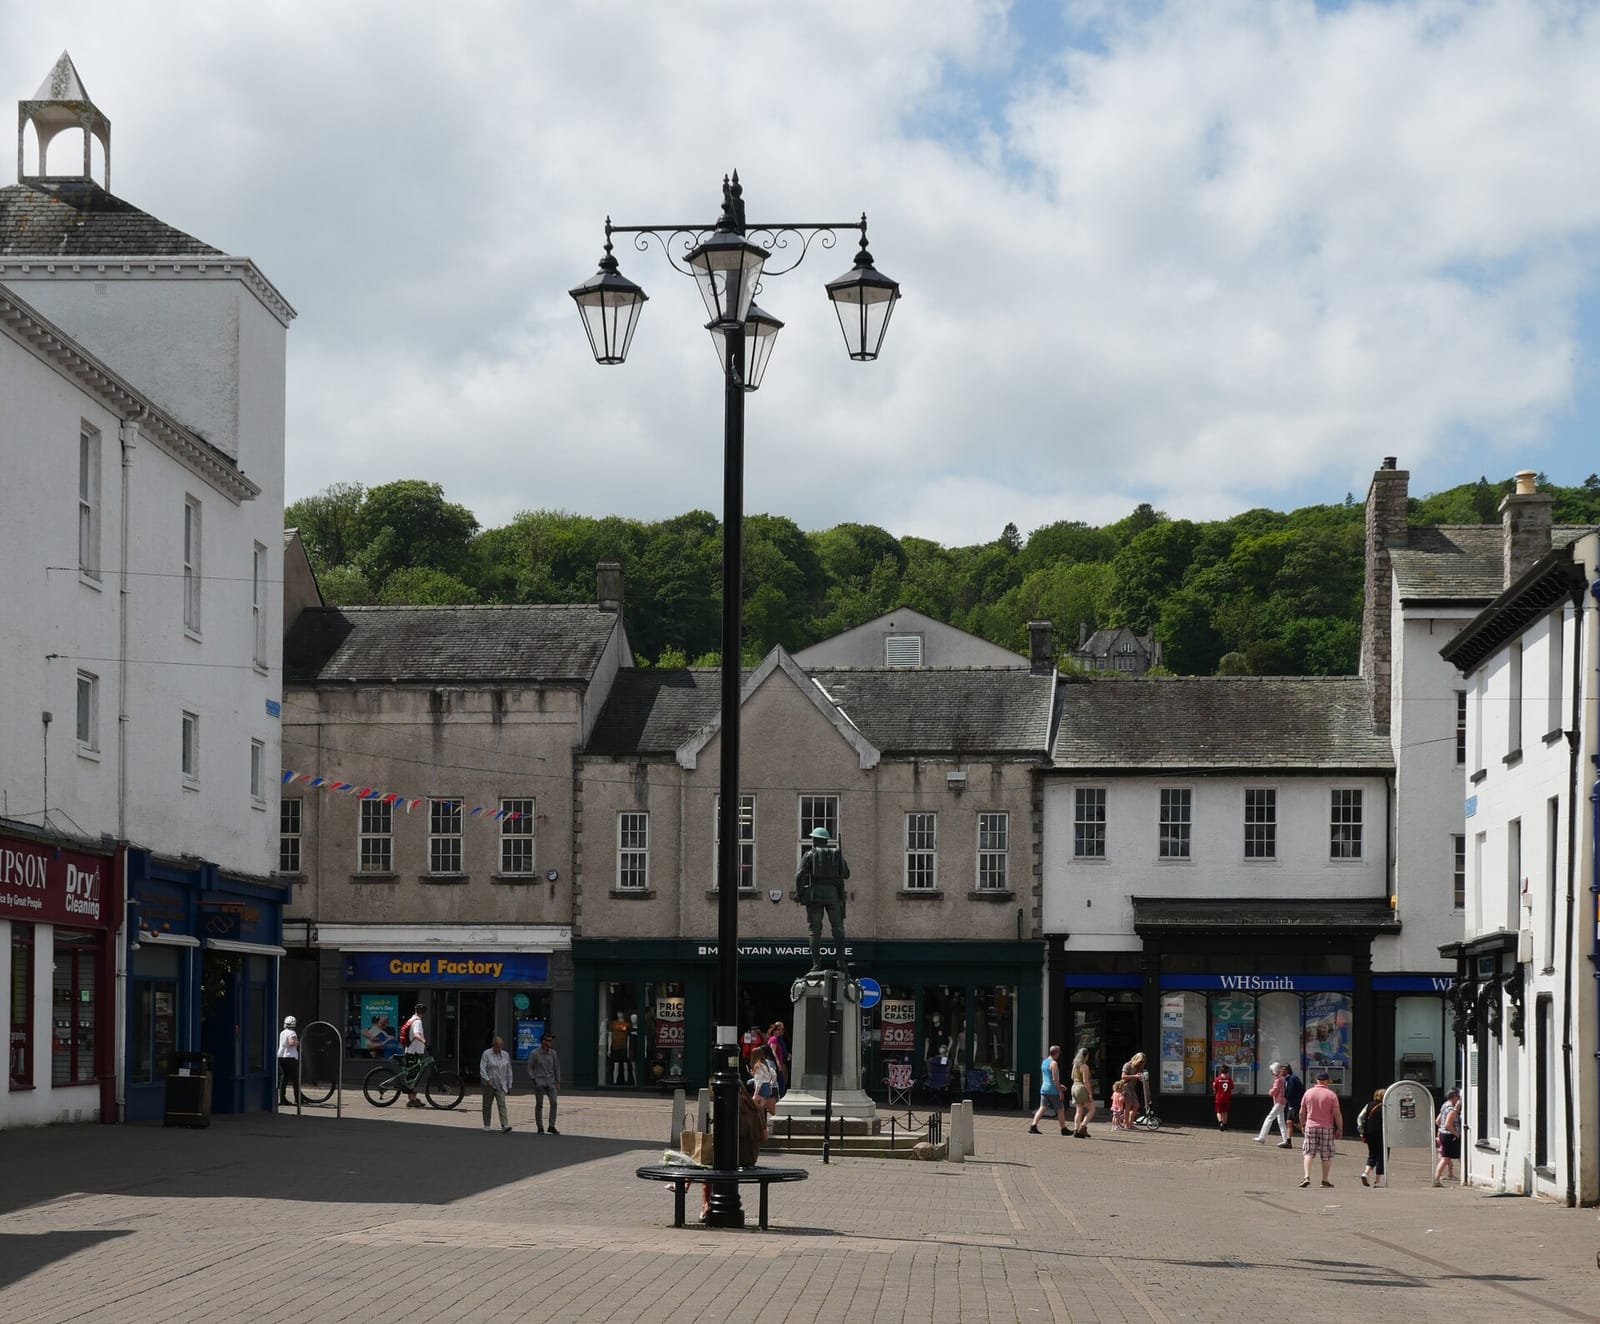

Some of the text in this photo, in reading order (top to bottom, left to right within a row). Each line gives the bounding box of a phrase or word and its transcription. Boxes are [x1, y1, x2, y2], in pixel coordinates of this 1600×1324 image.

[65, 863, 94, 899] Dry
[6, 893, 13, 907] By
[13, 894, 27, 907] Great
[26, 896, 43, 911] People
[65, 893, 101, 921] Cleaning
[707, 946, 854, 956] MNTAIN WAREOUE
[389, 959, 503, 978] Card Factory
[1219, 975, 1295, 991] WHSmith
[659, 1002, 683, 1011] PRIC
[884, 1004, 914, 1013] PRICE
[1217, 1001, 1232, 1020] 3
[1241, 1001, 1255, 1020] 2
[884, 1012, 914, 1020] CRASH
[884, 1029, 914, 1042] 50%
[1222, 1082, 1229, 1092] 9
